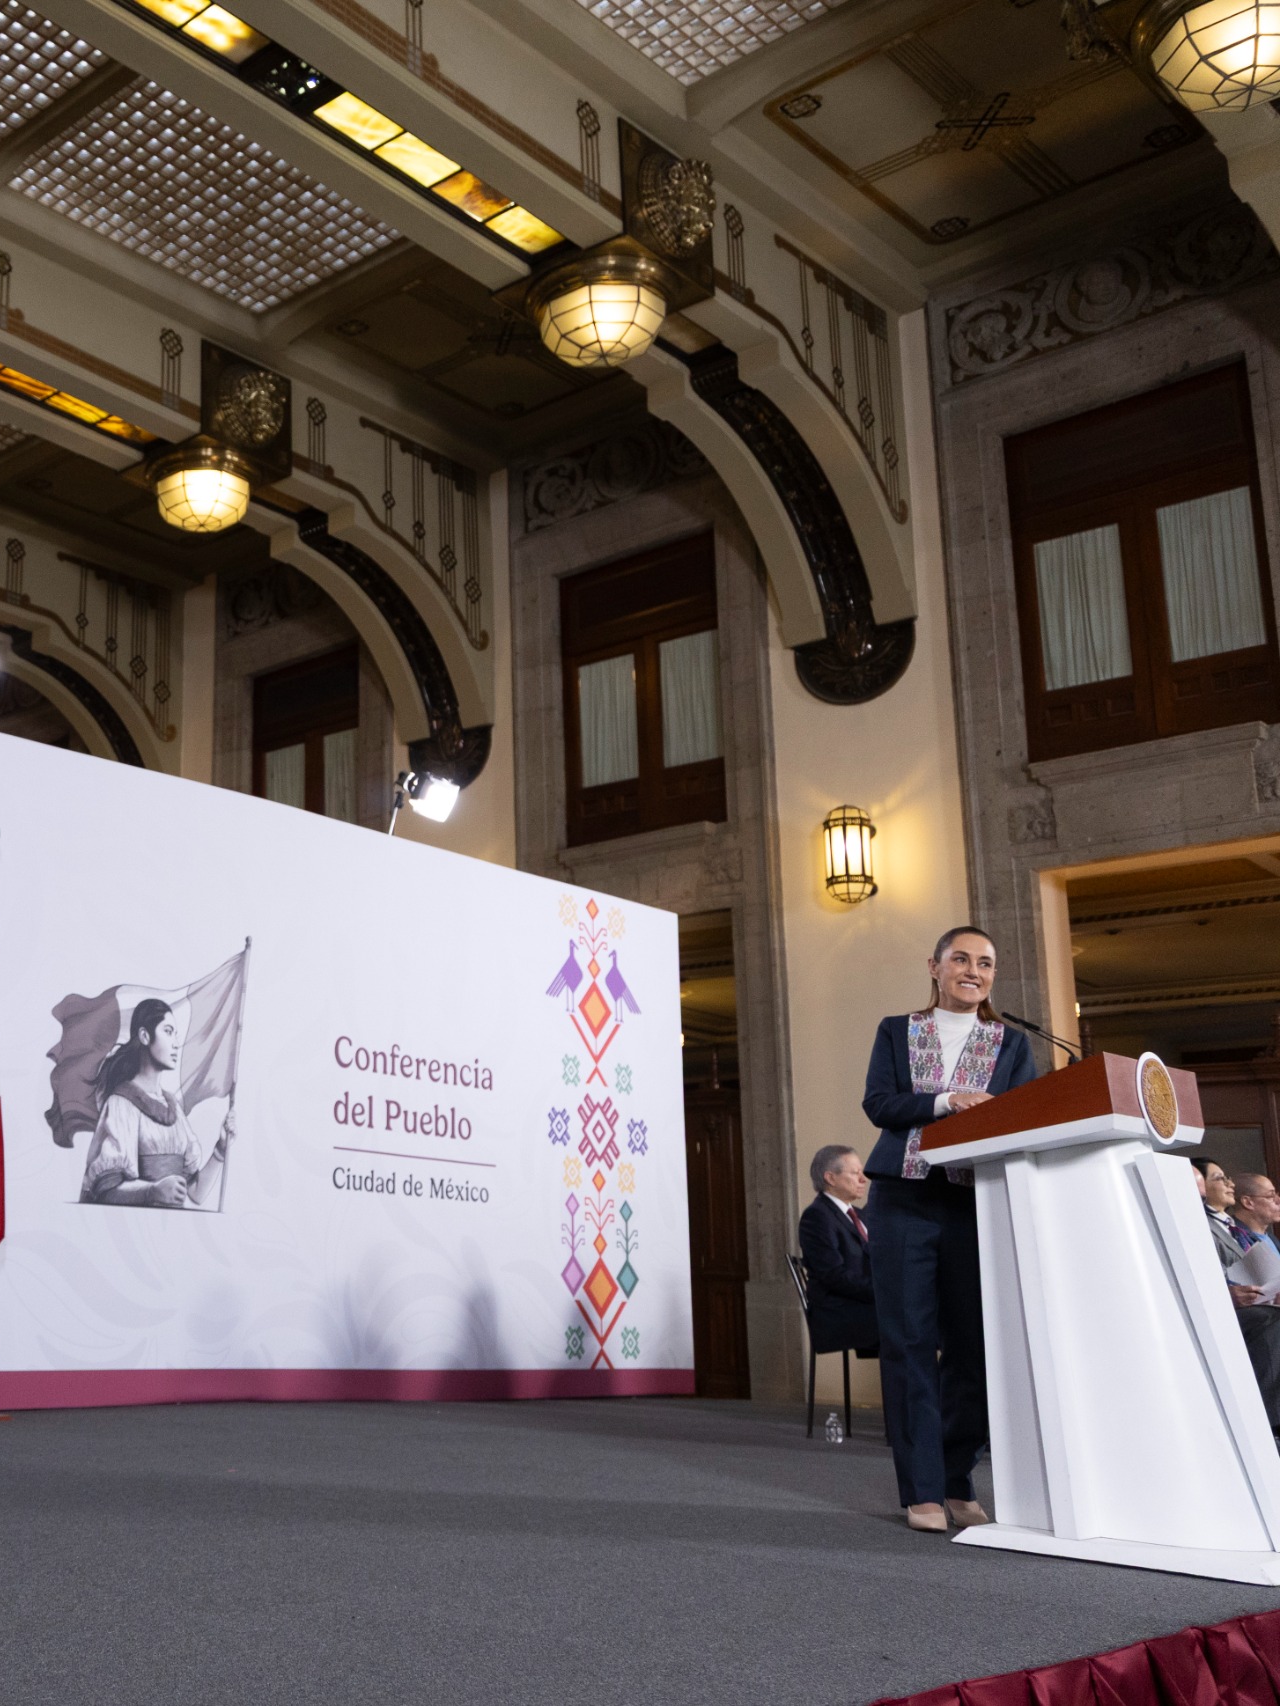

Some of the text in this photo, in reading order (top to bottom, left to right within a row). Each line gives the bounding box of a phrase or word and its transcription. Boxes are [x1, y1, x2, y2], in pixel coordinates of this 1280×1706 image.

[334, 1035, 493, 1091] Conferencia
[333, 1091, 472, 1140] del Pueblo
[332, 1167, 490, 1203] Ciudad de México
